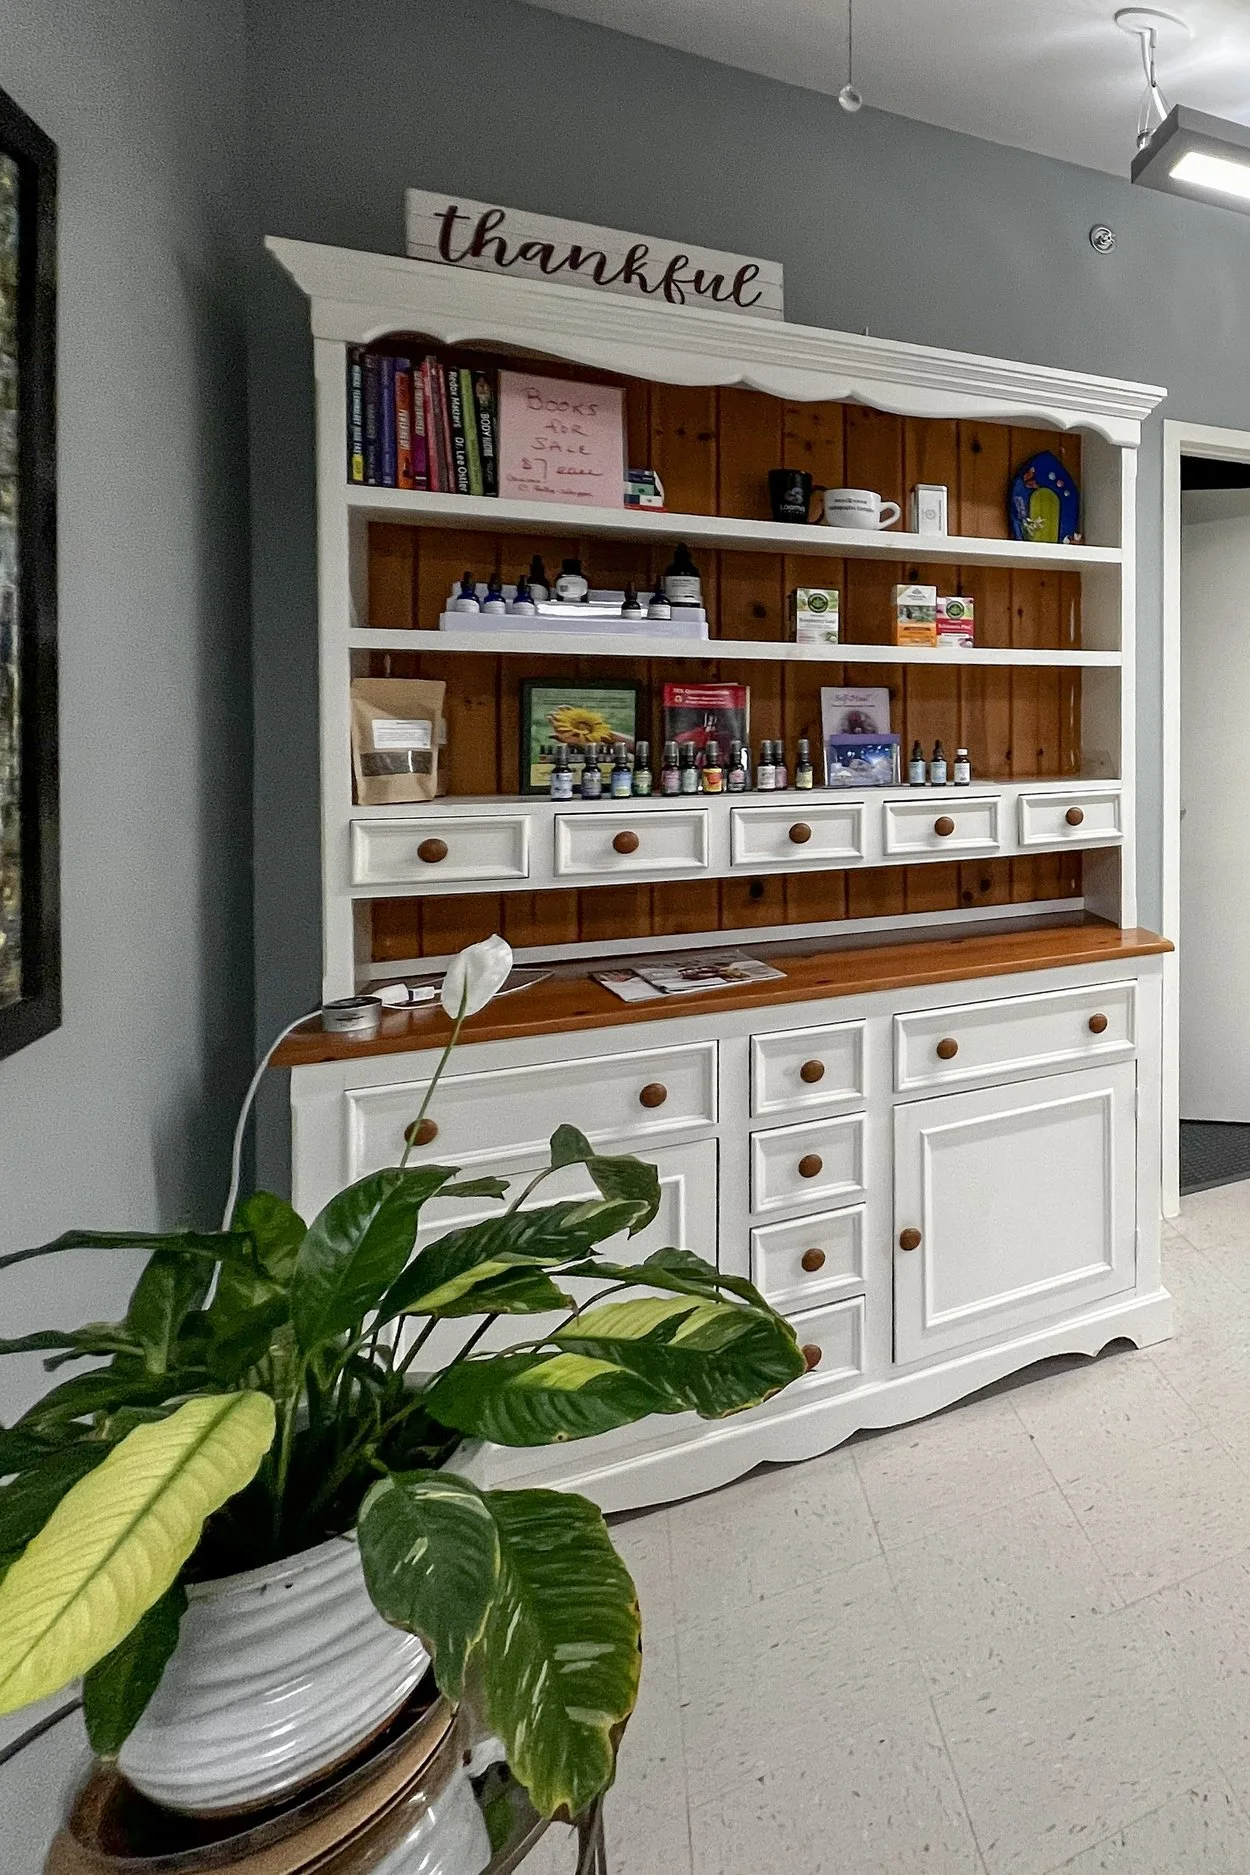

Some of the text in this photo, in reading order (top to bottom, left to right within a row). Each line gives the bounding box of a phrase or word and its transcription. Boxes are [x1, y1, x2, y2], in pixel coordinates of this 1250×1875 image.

[434, 205, 763, 307] thankful
[449, 371, 459, 397] Redox
[451, 397, 462, 429] Matters
[480, 413, 491, 436] BODY
[456, 450, 465, 467] Lee
